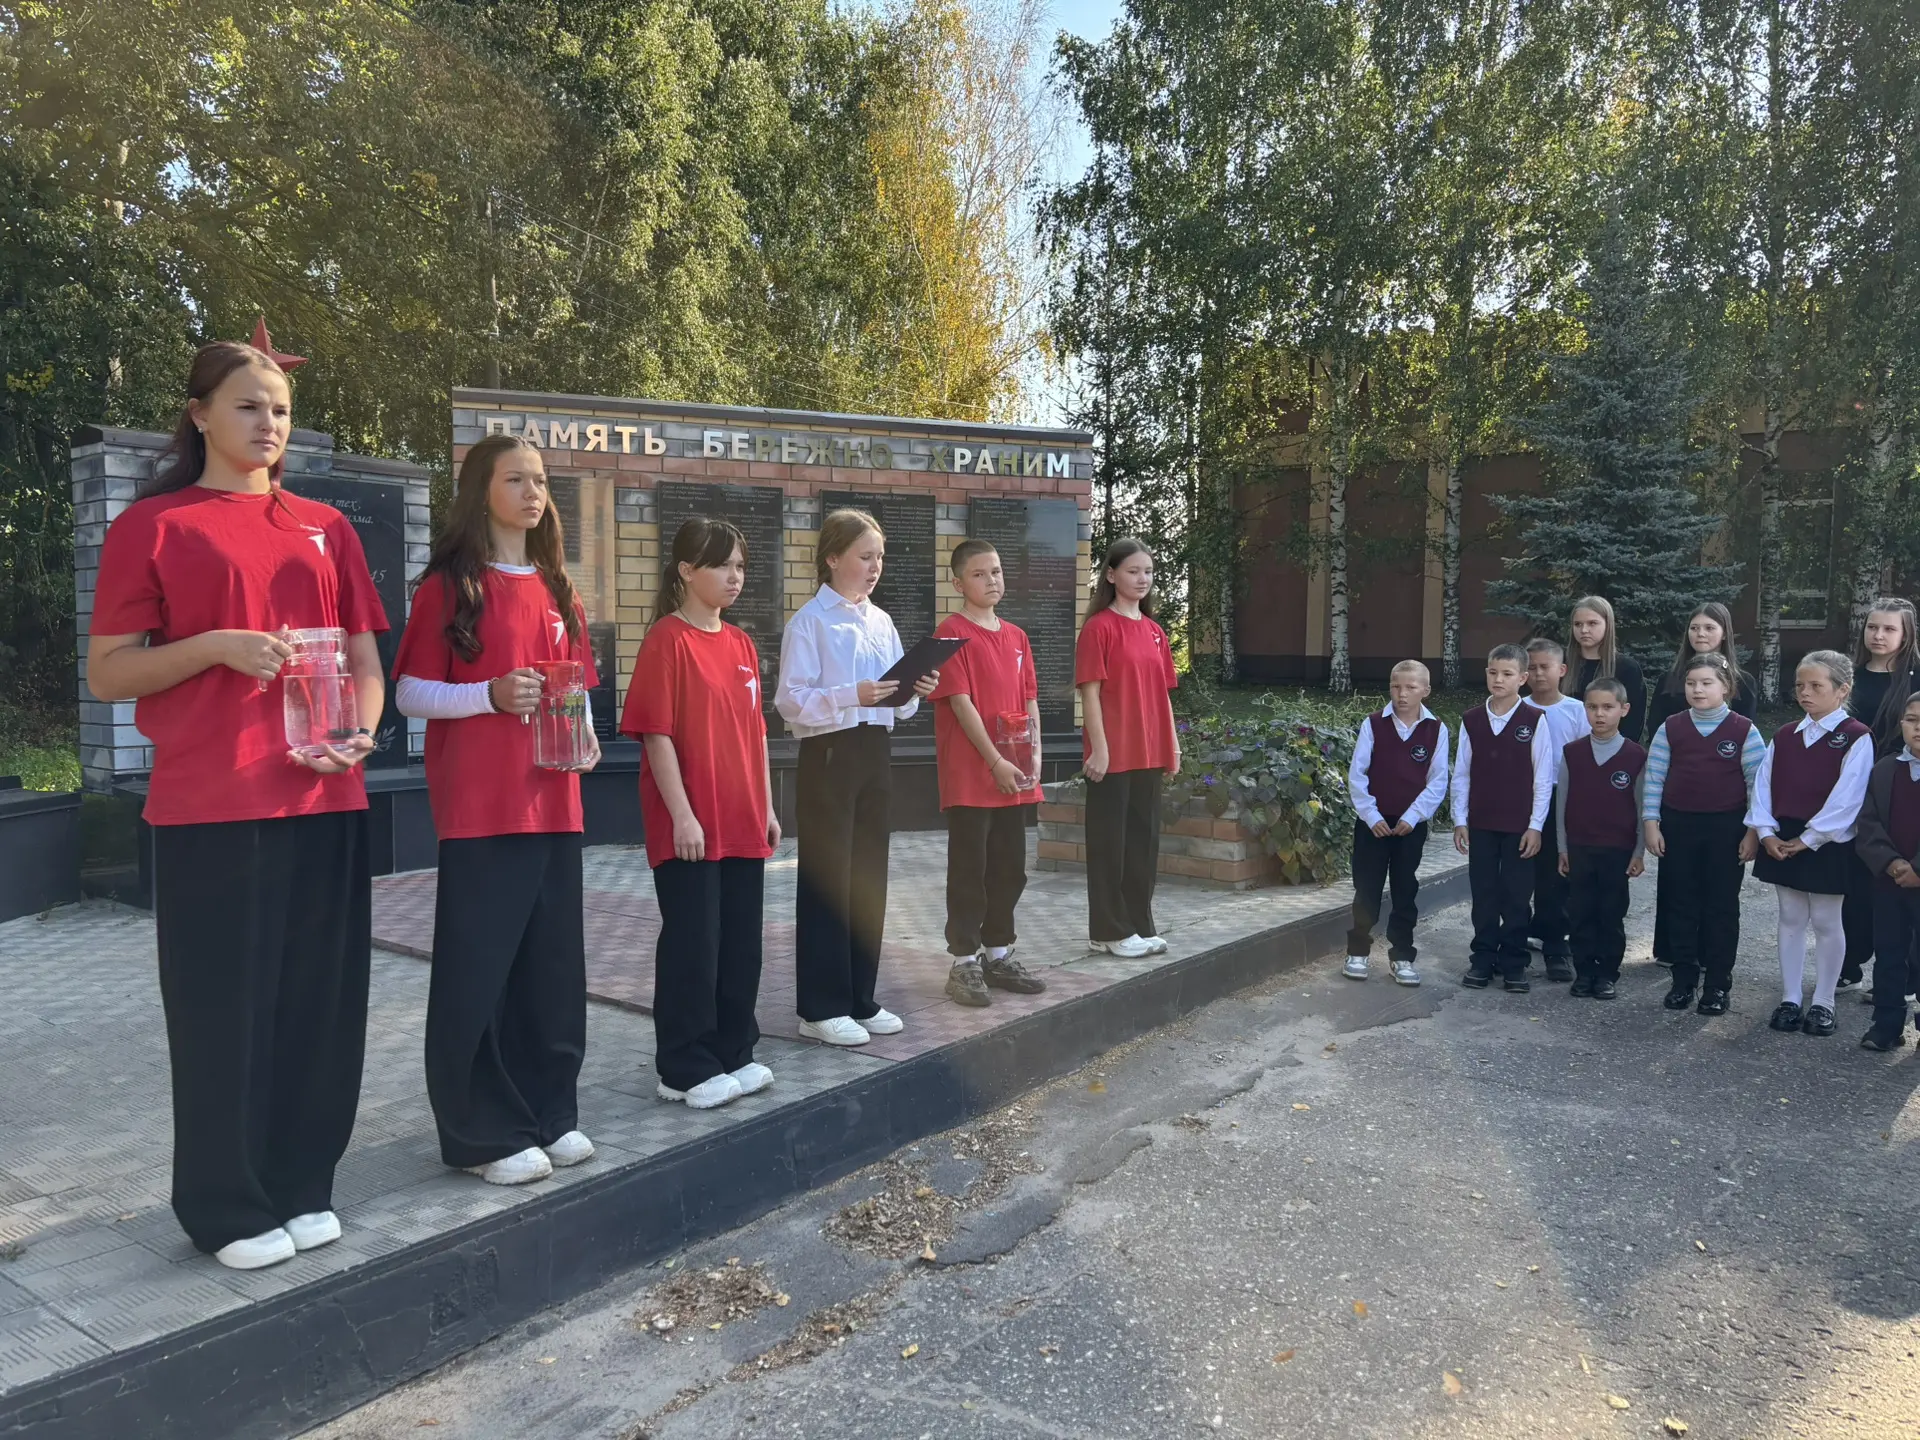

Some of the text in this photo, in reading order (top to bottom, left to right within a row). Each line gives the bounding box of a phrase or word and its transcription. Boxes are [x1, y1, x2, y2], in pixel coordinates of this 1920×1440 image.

[486, 417, 1070, 478] ПАМЯТЬ БЕРЕЖНО ХРАНИМ
[343, 514, 374, 524] изма.
